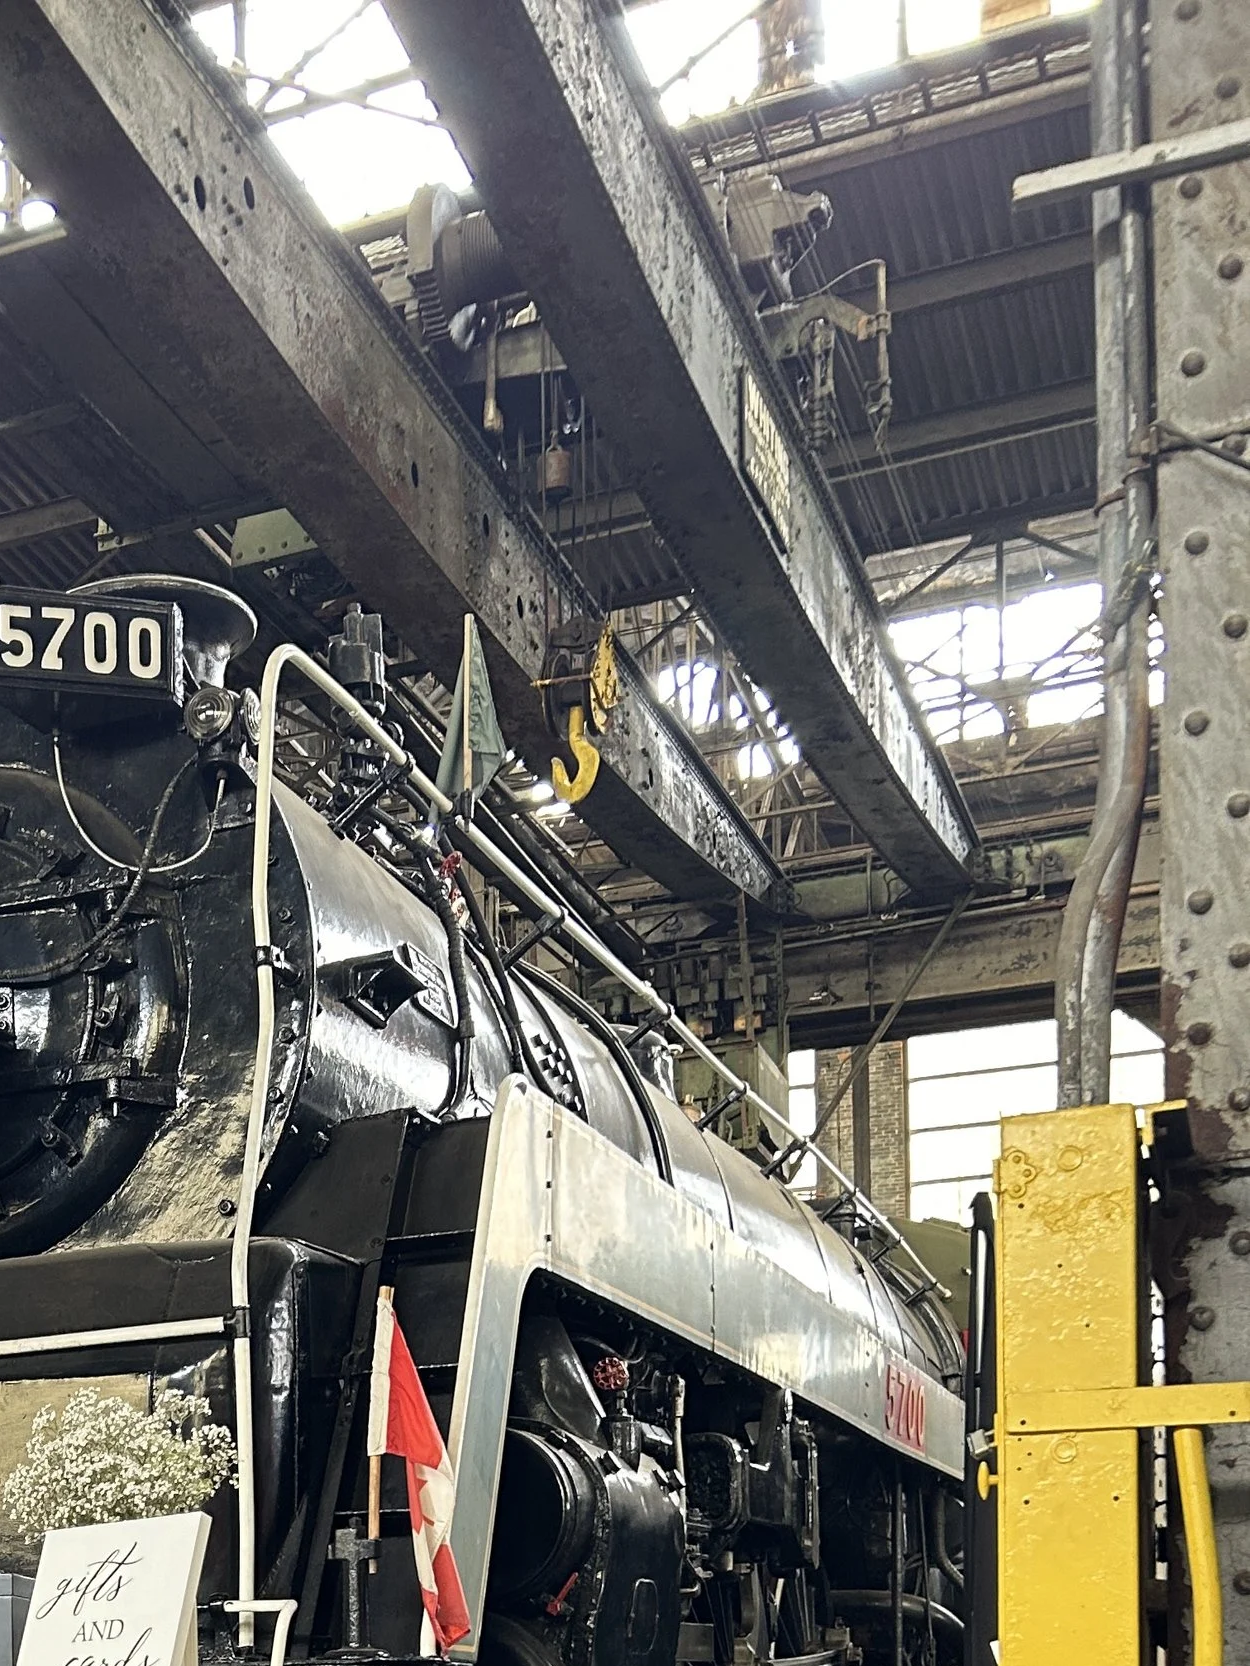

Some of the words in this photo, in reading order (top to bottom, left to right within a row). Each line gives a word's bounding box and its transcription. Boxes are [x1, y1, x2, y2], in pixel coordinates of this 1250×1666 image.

[884, 1363, 927, 1448] 5700
[35, 1541, 144, 1620] gifts
[71, 1618, 125, 1643] AND
